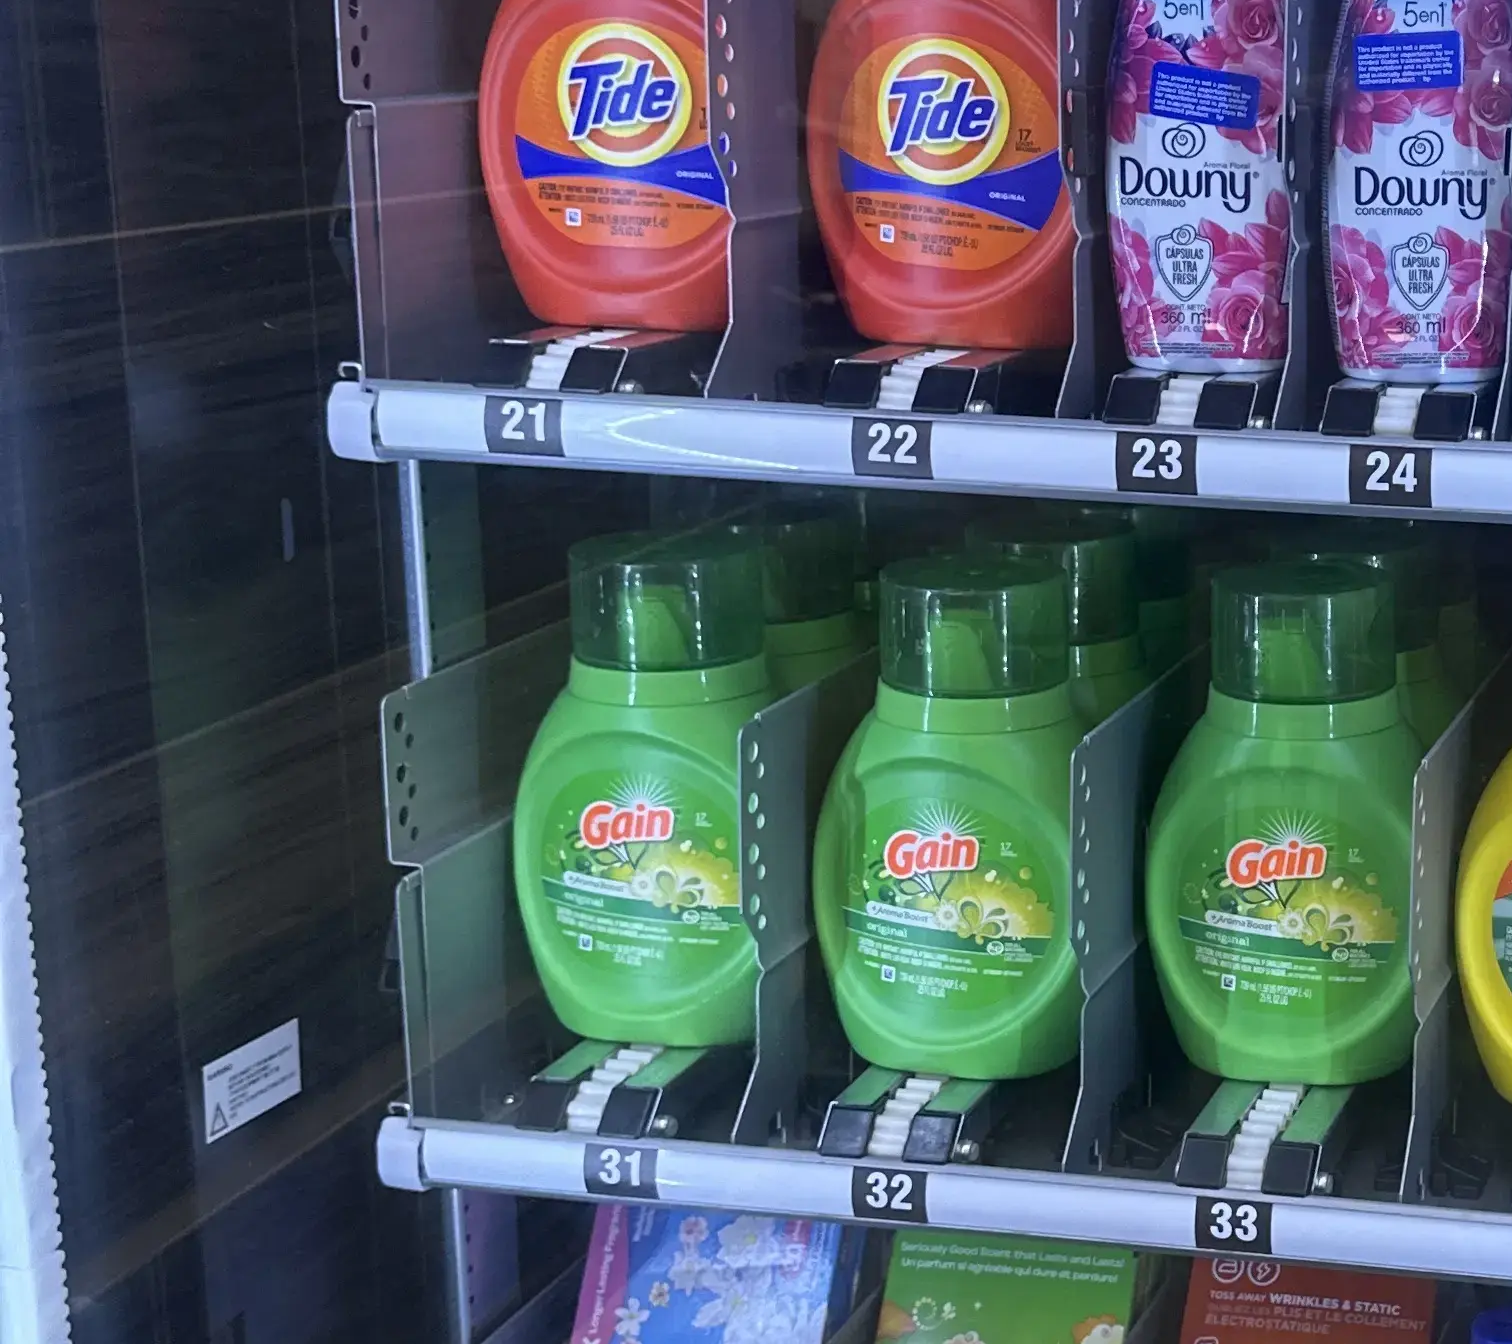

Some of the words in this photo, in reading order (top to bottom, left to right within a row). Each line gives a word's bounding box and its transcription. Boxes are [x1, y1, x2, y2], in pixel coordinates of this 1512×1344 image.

[568, 59, 679, 140] Tide
[886, 76, 999, 156] Tide
[1017, 128, 1032, 141] 17
[1118, 156, 1251, 213] Downy
[1353, 166, 1488, 220] Downy
[1120, 197, 1186, 208] CONCENTRADO
[1355, 207, 1423, 216] CONCENTRADO
[1172, 261, 1198, 273] ULTRA
[1172, 273, 1198, 286] FRESH
[1408, 269, 1434, 281] ULTRA
[1408, 281, 1434, 294] FRESH
[1160, 312, 1186, 325] 360
[1426, 319, 1446, 334] ml
[501, 400, 548, 442] 21
[867, 423, 918, 465] 22
[1132, 438, 1183, 481] 23
[1365, 451, 1418, 493] 24
[580, 801, 674, 848] Gain
[884, 830, 979, 879] Gain
[1226, 839, 1327, 888] Gain
[866, 922, 908, 939] original
[1205, 930, 1250, 948] original
[599, 1148, 642, 1187] 31
[865, 1172, 913, 1212] 32
[1209, 1202, 1259, 1242] 33
[902, 1242, 948, 1255] Seriously
[949, 1244, 979, 1256] Good
[1014, 1249, 1036, 1260] that
[1039, 1252, 1068, 1263] Lasts
[1070, 1254, 1091, 1265] and
[902, 1257, 915, 1267] Un
[916, 1259, 956, 1270] parfum
[1210, 1290, 1236, 1301] TOSS
[1237, 1292, 1266, 1303] AWAY
[1269, 1293, 1339, 1309] WRINKLES
[1342, 1300, 1351, 1310] &
[1354, 1301, 1401, 1316] STATIC
[1306, 1309, 1321, 1320] ET
[1325, 1311, 1341, 1323] LE
[1344, 1312, 1427, 1332] COLLEMENT
